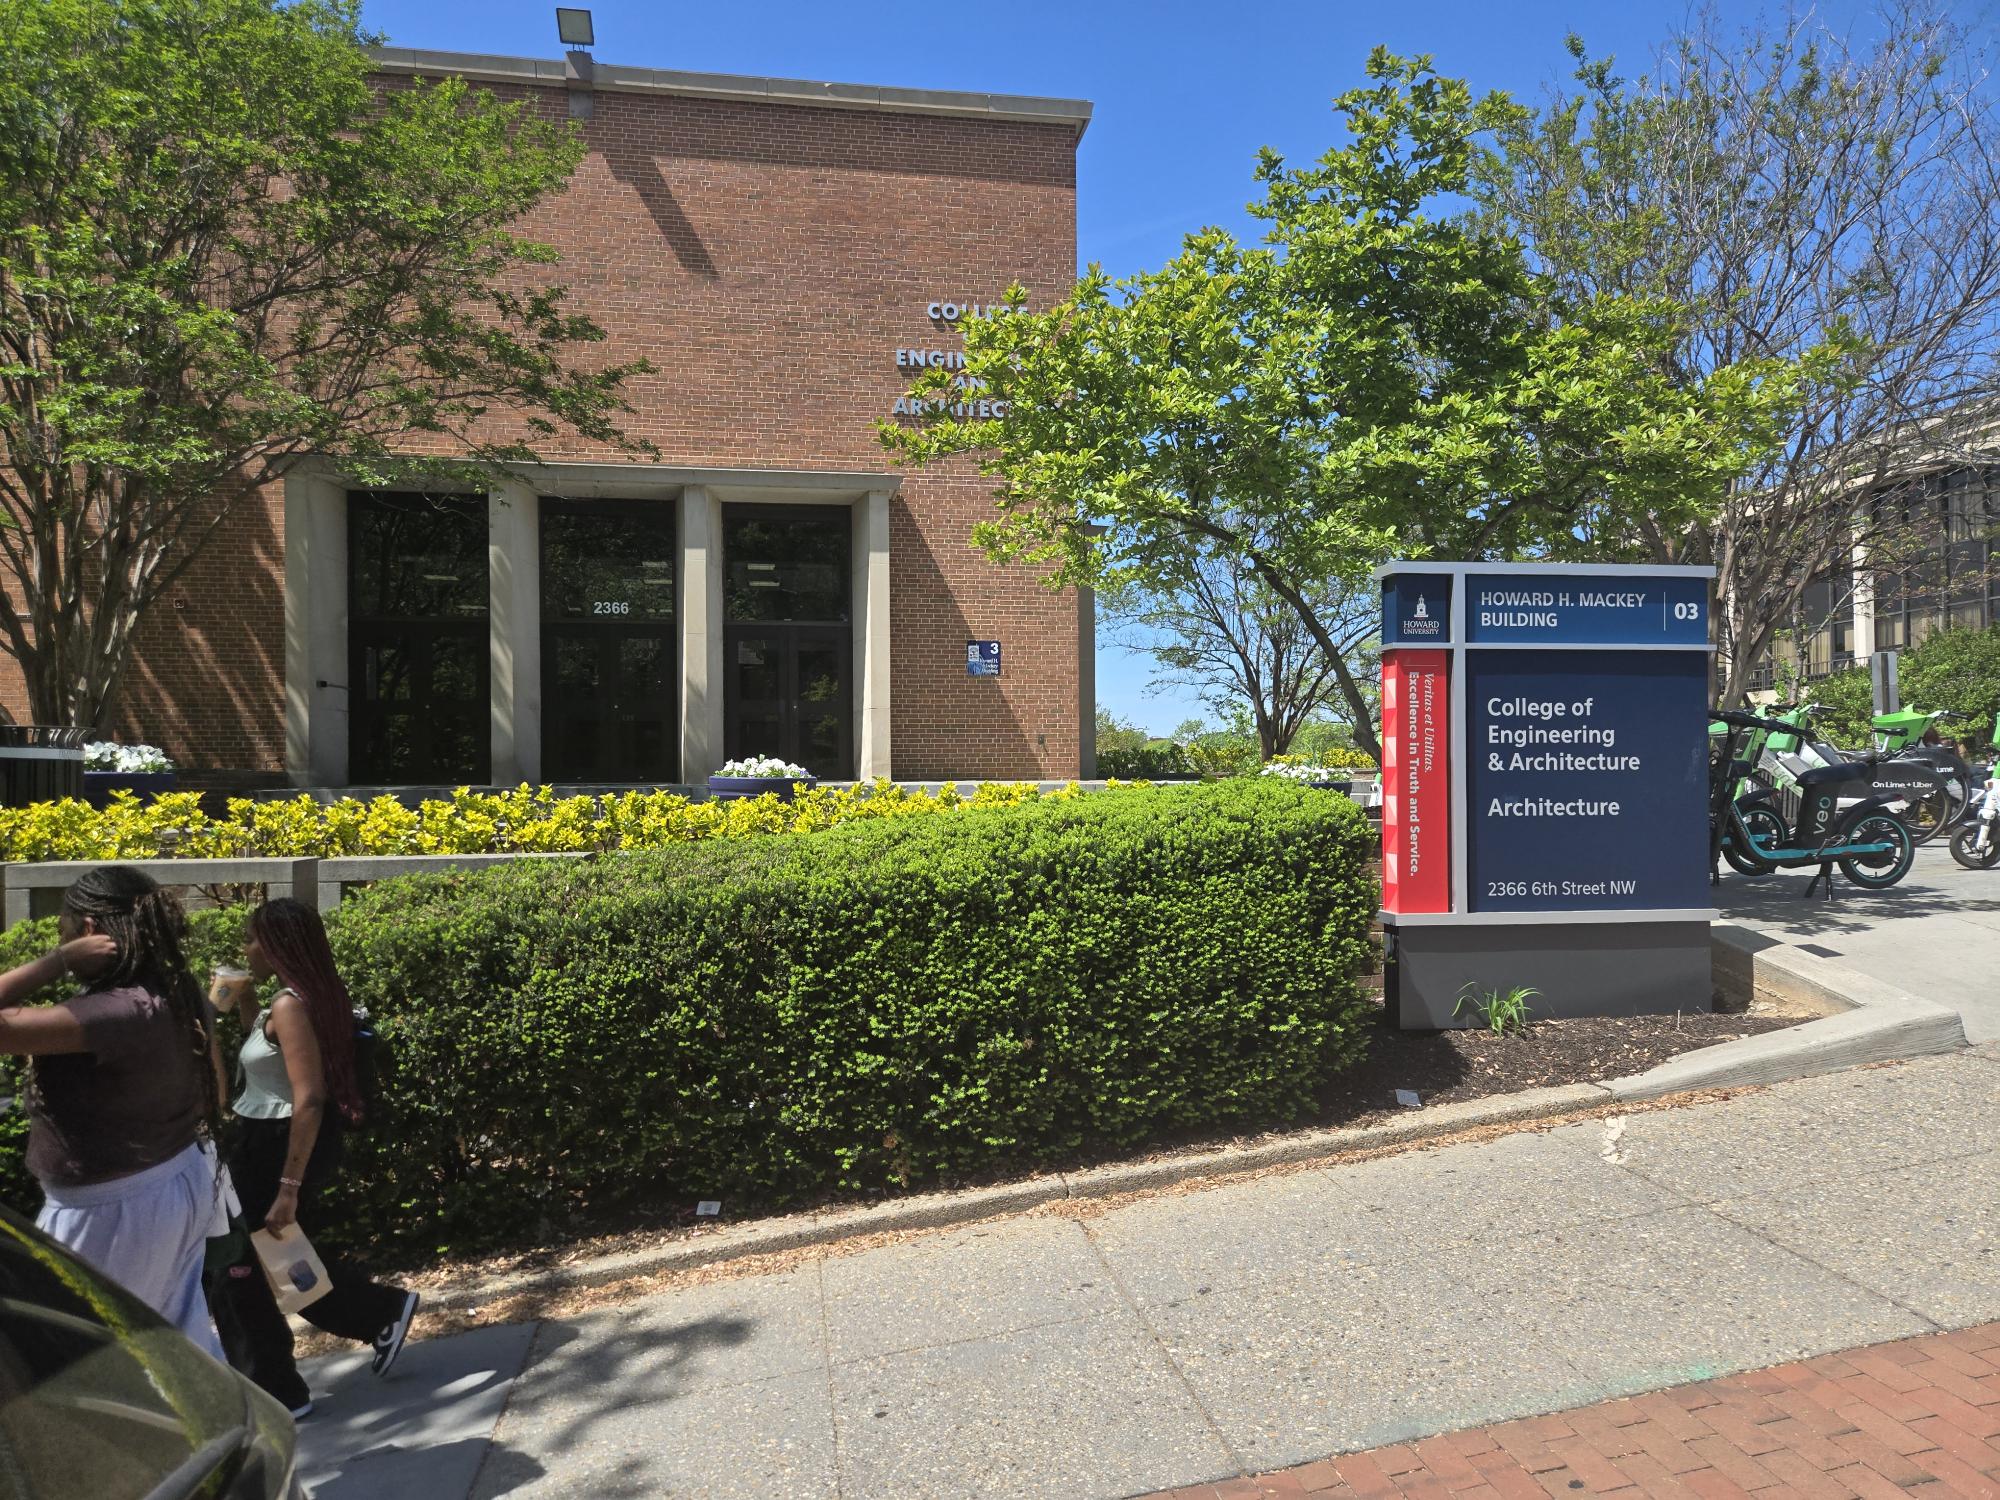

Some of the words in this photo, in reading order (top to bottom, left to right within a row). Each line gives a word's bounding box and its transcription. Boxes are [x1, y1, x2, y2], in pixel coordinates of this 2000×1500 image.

[593, 601, 629, 615] 2366
[1481, 591, 1554, 607] HOWARD
[1558, 592, 1575, 607] H.
[1579, 592, 1646, 608] MACKEY
[1481, 612, 1558, 627] BUILDING
[1674, 602, 1699, 620] 03
[1403, 620, 1440, 629] HOWARD
[990, 643, 999, 654] 3
[1424, 673, 1435, 712] Veritas
[1408, 671, 1420, 739] Excellence
[1487, 697, 1566, 721] College
[1571, 697, 1594, 717] of
[1424, 713, 1433, 726] et
[1488, 724, 1615, 748] Engineering
[1409, 742, 1420, 755] in
[1424, 727, 1435, 773] Utilitas.
[1487, 752, 1505, 772] &
[1508, 752, 1641, 772] Architecture
[1409, 757, 1420, 794] Truth
[1409, 797, 1420, 823] and
[1487, 797, 1620, 817] Architecture
[1813, 796, 1832, 834] veo
[1409, 825, 1421, 877] Service.
[1488, 881, 1527, 897] 2366
[1531, 881, 1558, 896] 6th
[1561, 880, 1606, 896] Street
[1610, 880, 1636, 895] NW
